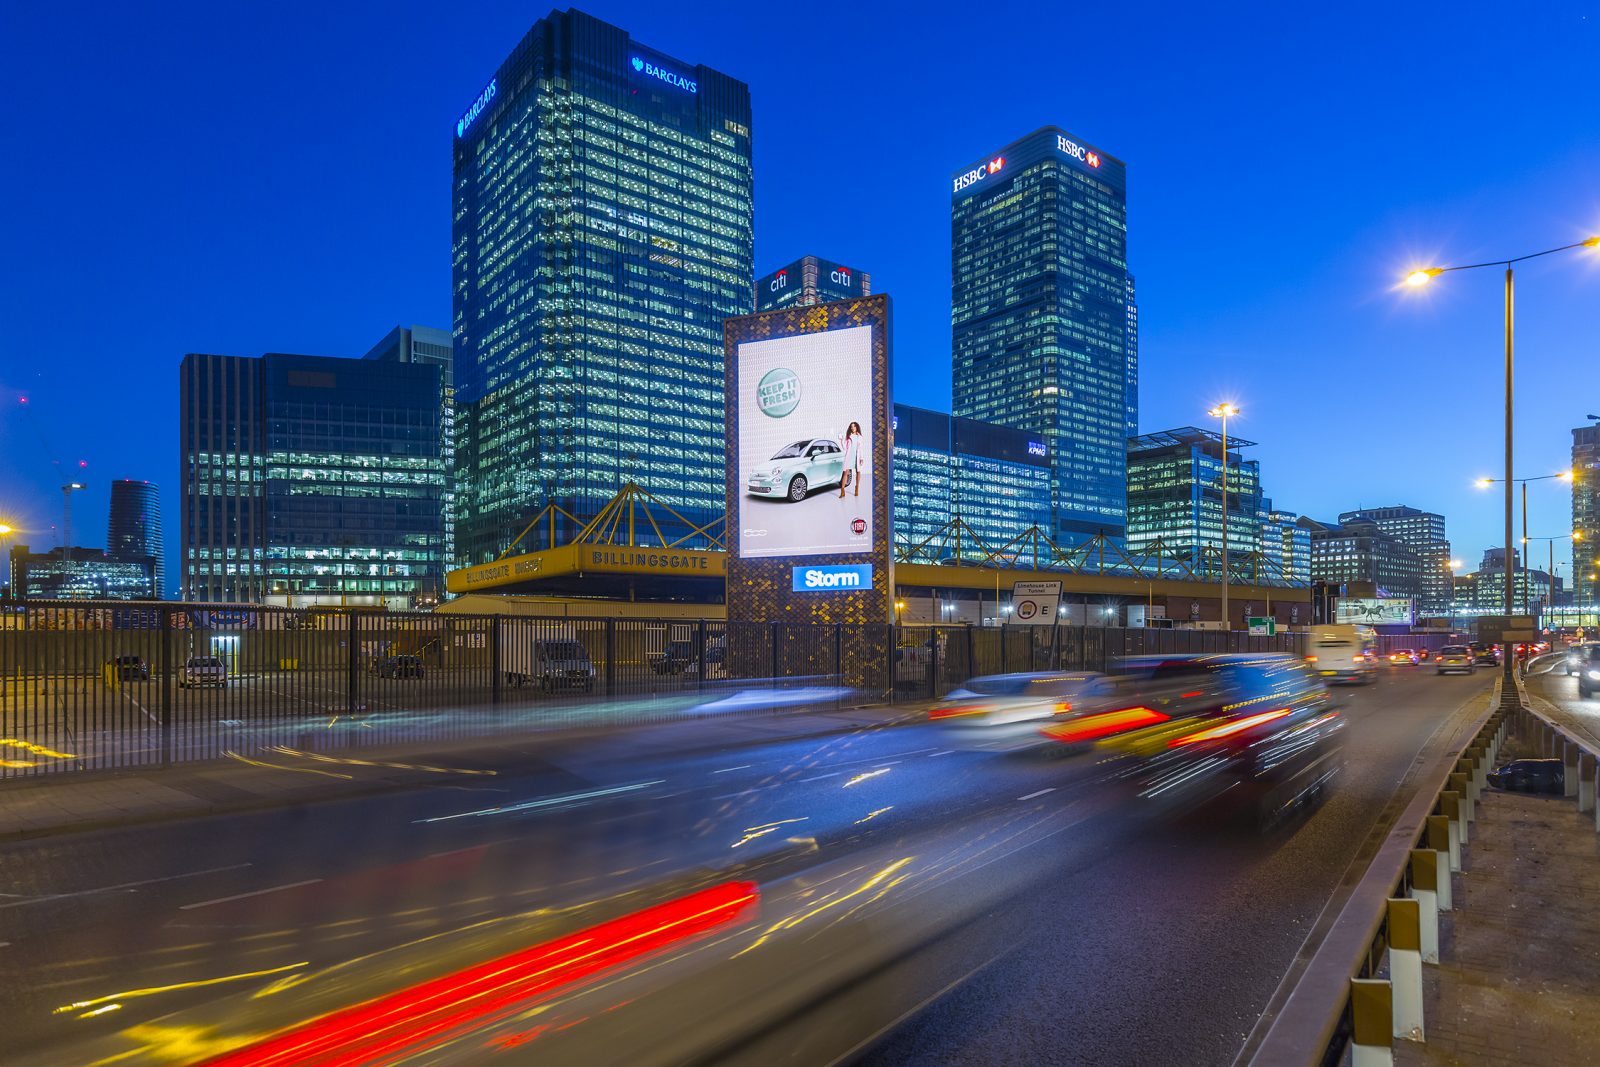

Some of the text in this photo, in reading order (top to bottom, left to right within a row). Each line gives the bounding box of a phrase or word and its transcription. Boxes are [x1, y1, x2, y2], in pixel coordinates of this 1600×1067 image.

[645, 63, 697, 93] BARCLAYS
[464, 78, 496, 130] BARCLAYS
[1057, 135, 1086, 162] HSBC
[953, 165, 986, 193] HSBC
[759, 379, 797, 397] KEEP IT
[763, 390, 796, 406] FRESH
[1028, 447, 1046, 456] KPMG
[854, 522, 864, 531] FIAT
[592, 551, 708, 569] BILLINGSGATE
[466, 564, 510, 584] BILLINGSGATE
[805, 569, 860, 588] Storm
[1042, 606, 1048, 615] E
